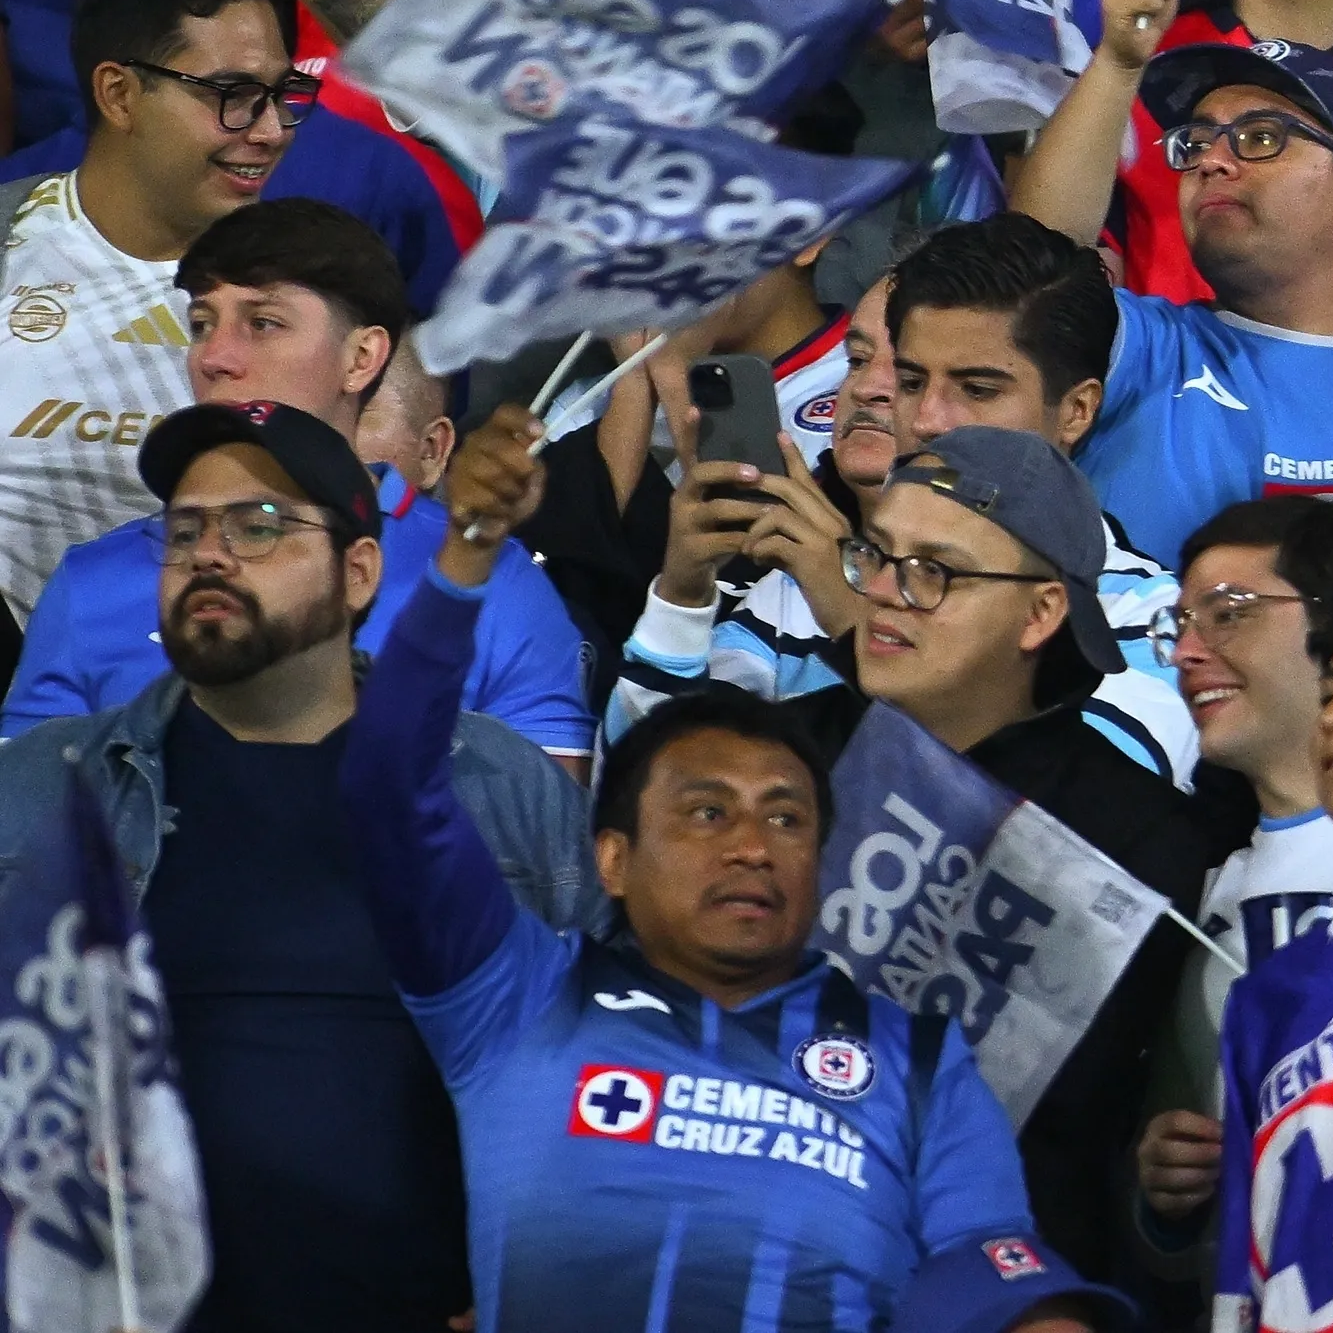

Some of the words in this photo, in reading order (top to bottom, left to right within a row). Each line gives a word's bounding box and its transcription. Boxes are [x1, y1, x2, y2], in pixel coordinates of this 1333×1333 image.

[662, 1074, 865, 1149] CEMENTO
[654, 1113, 764, 1159] CRUZ
[769, 1130, 869, 1191] AZUL
